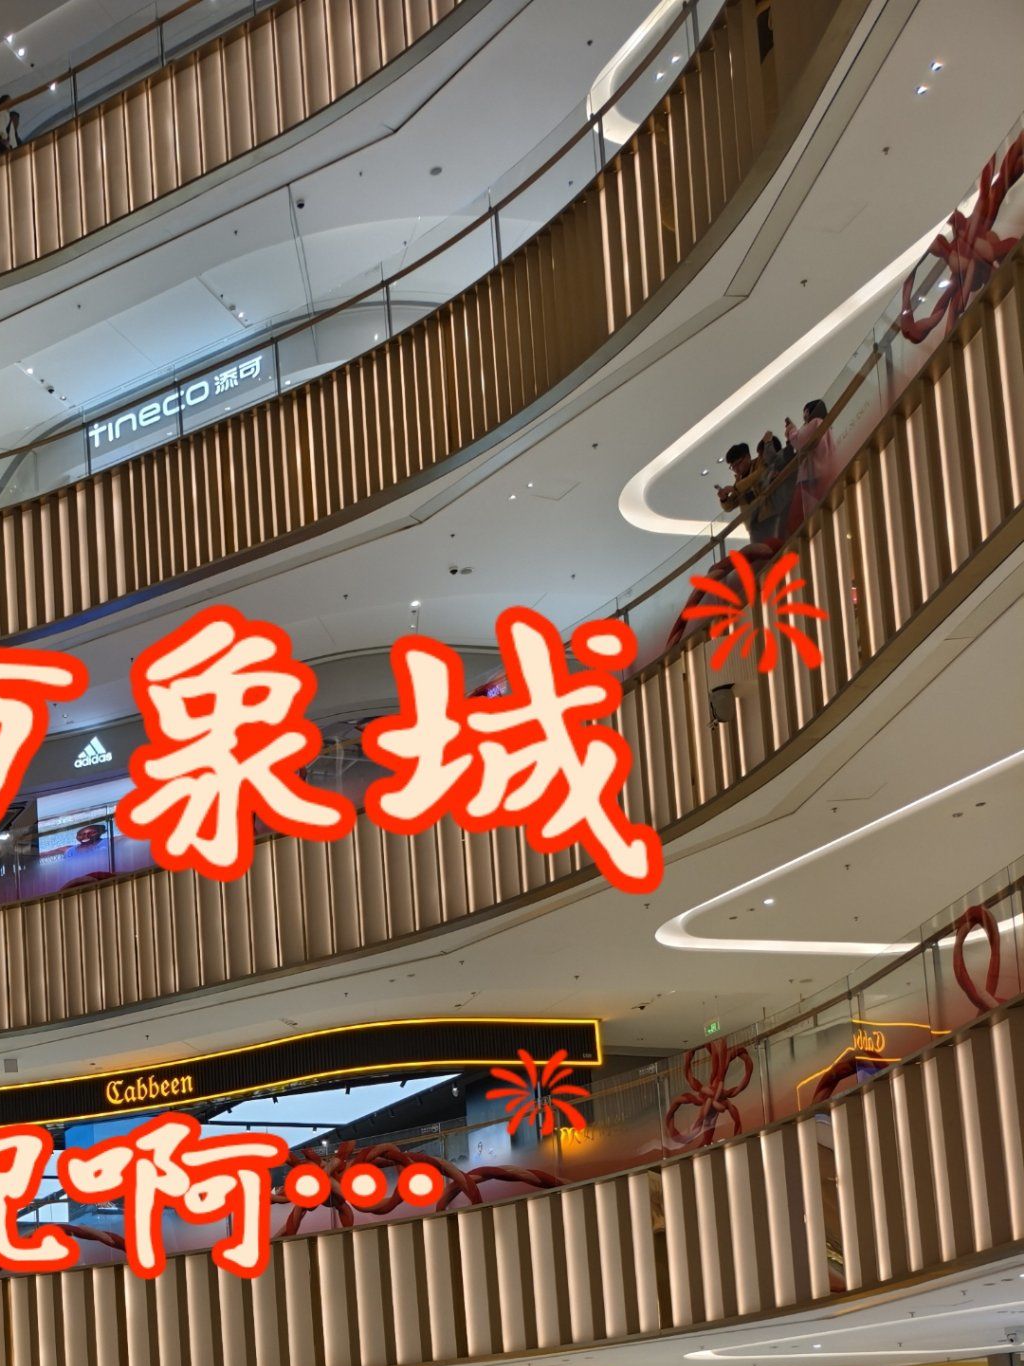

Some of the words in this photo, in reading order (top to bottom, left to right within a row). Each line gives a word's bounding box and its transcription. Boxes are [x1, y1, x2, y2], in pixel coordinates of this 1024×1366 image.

[214, 355, 263, 395] 添可
[74, 752, 112, 768] adidas
[106, 1075, 194, 1105] Cabbeen
